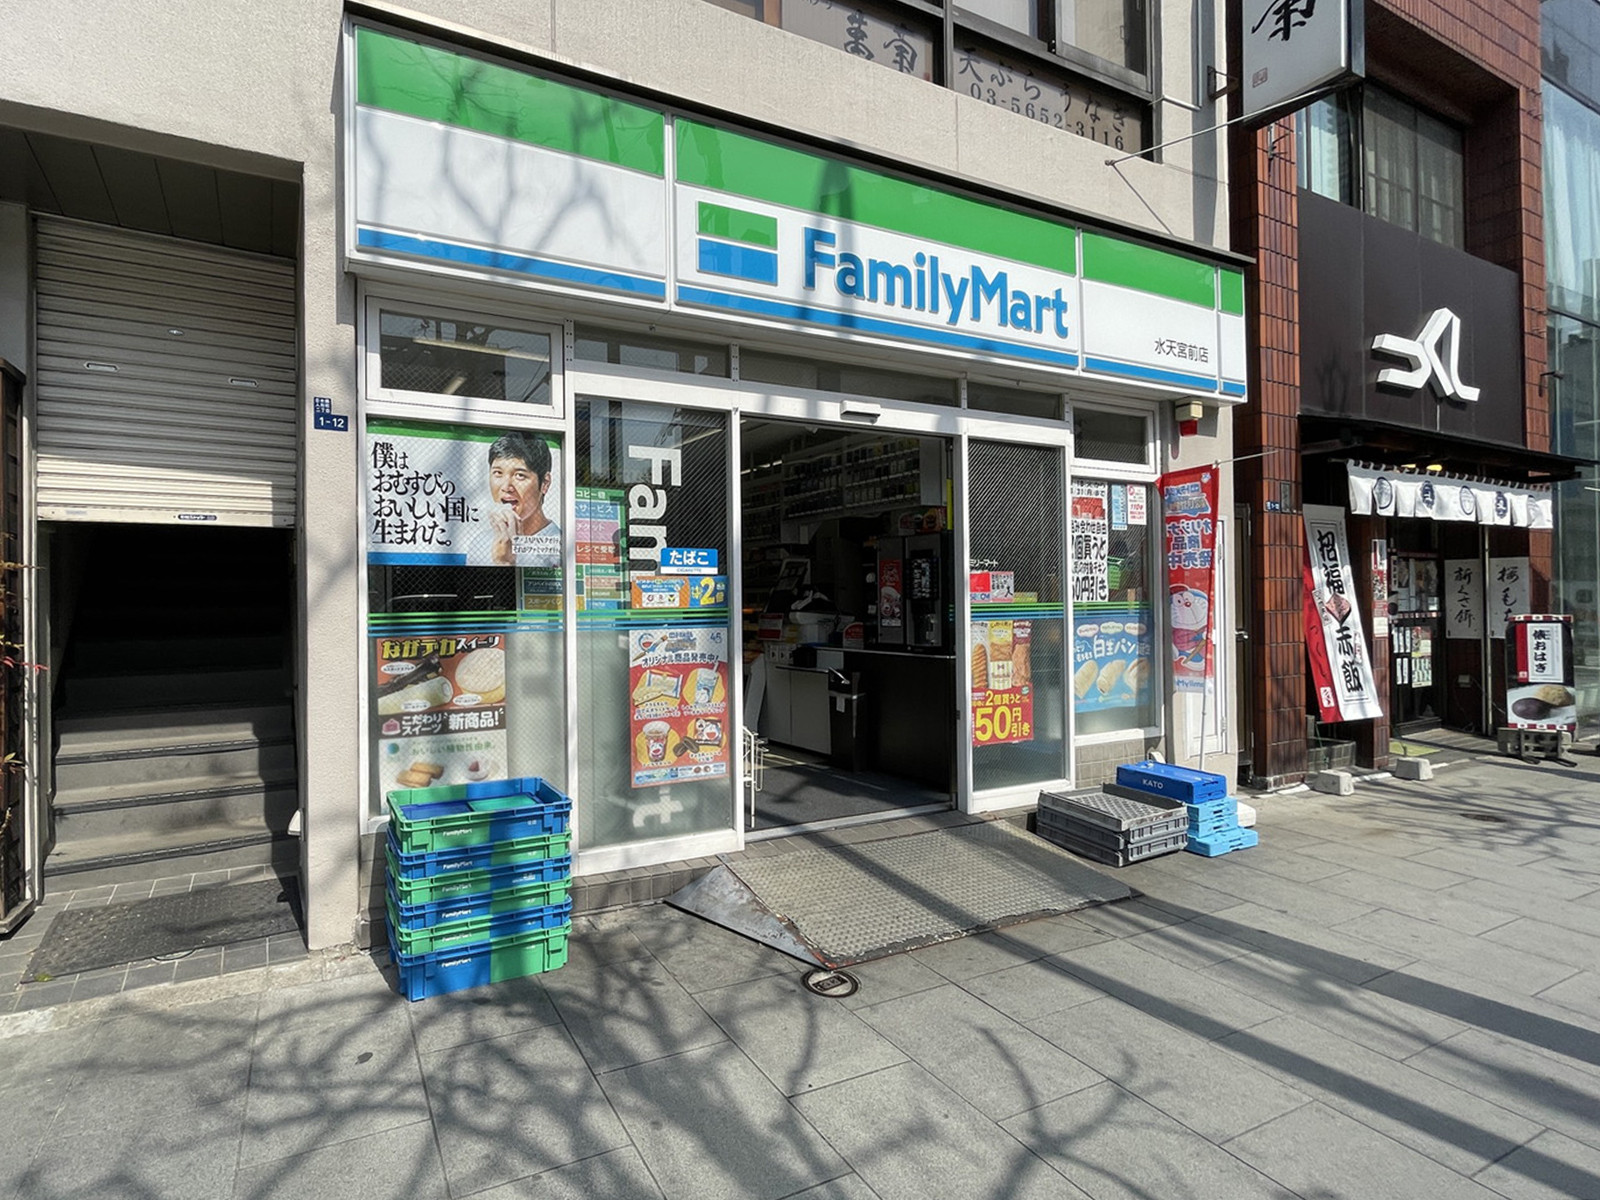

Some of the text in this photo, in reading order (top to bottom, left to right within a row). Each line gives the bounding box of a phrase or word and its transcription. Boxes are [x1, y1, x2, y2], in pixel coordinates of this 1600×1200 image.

[803, 226, 1069, 340] FamilyMart
[1154, 337, 1209, 363] 水天宮前店
[319, 416, 345, 429] 1-12
[371, 441, 409, 470] 僕は
[371, 470, 456, 496] おむすびの
[372, 495, 480, 523] おいしい国に
[372, 519, 453, 547] 生まれた。
[669, 550, 709, 565] たばこ
[1071, 535, 1107, 562] 個買うと
[402, 714, 442, 726] こだわり
[402, 723, 442, 736] スイーツ
[449, 711, 499, 730] 新商品!
[1142, 779, 1163, 789] KATO
